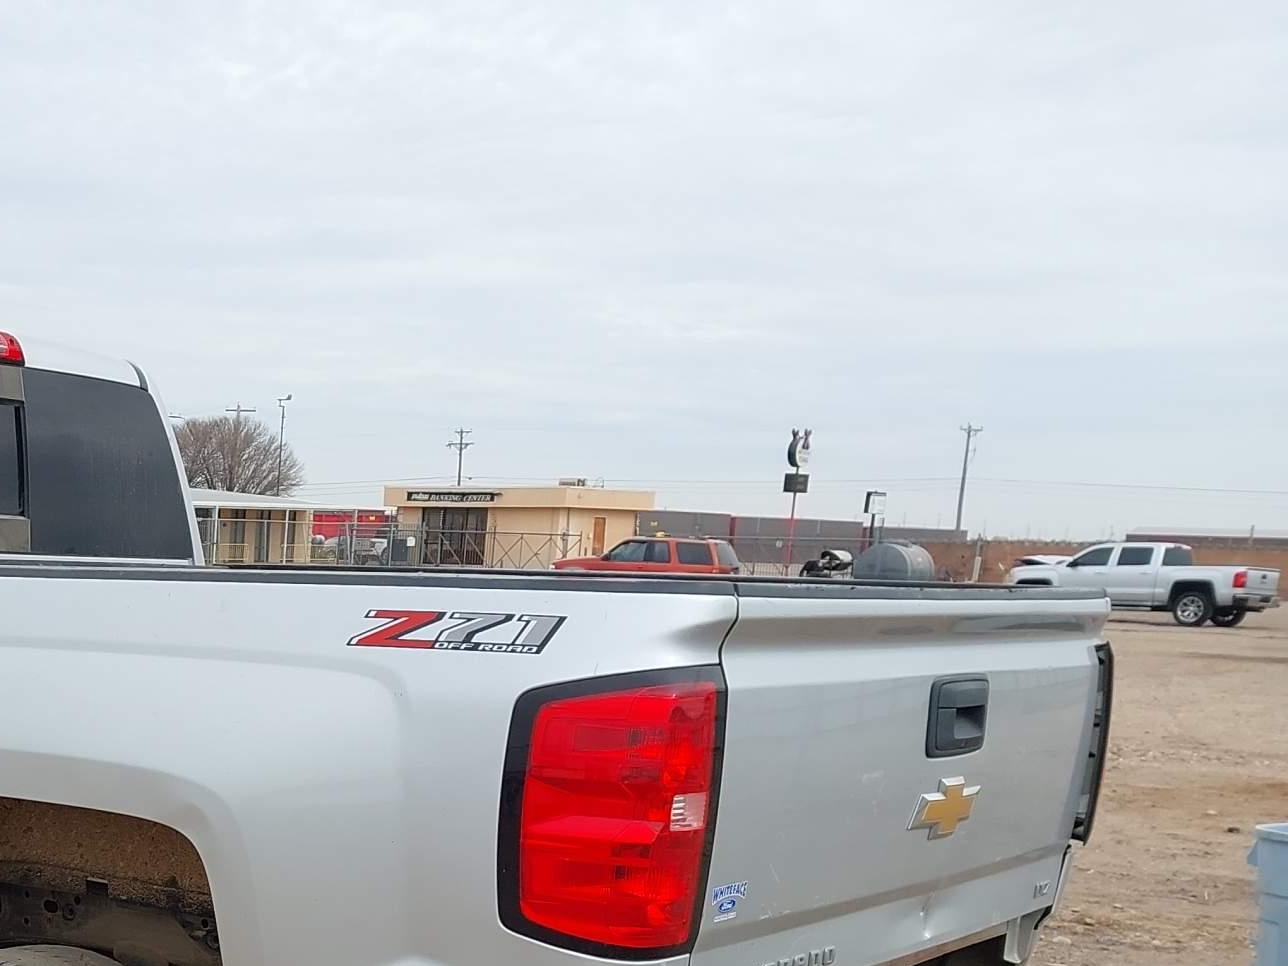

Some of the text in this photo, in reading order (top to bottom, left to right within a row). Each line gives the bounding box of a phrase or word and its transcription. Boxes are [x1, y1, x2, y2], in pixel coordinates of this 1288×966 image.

[429, 494, 462, 502] BANKING
[347, 609, 568, 650] Z71
[434, 641, 539, 653] OFF ROAD
